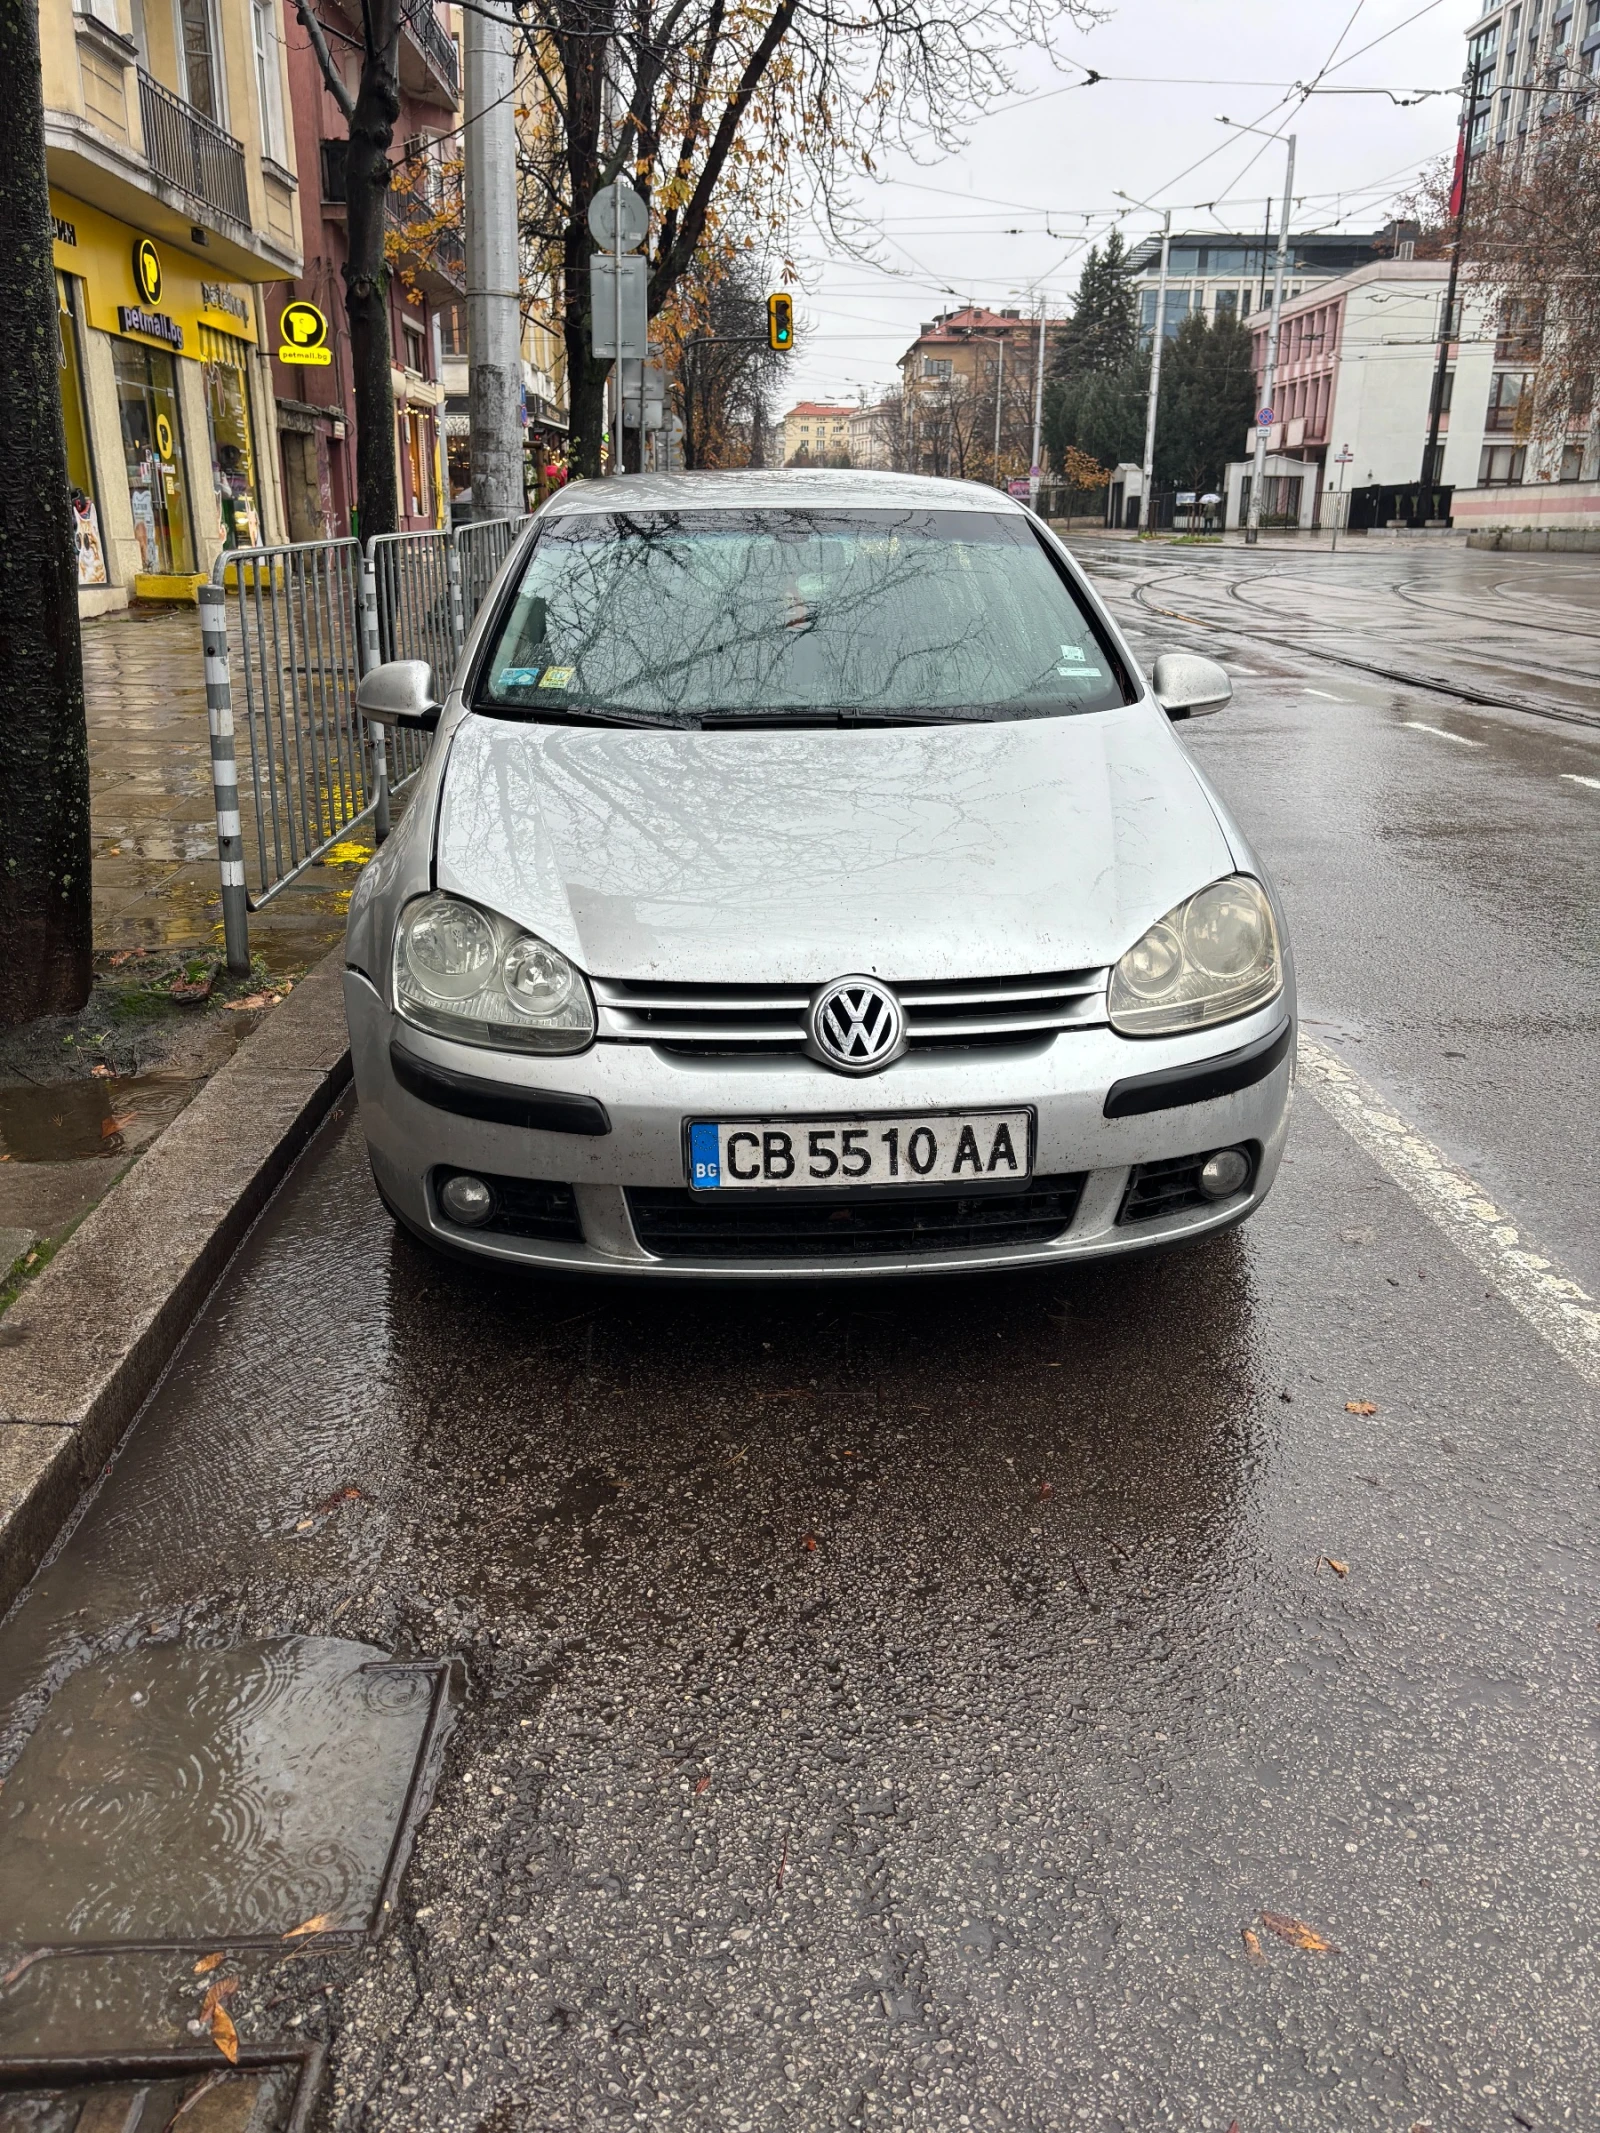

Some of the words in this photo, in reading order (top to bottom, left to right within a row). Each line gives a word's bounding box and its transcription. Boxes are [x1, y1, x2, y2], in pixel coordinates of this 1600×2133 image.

[120, 306, 183, 349] petmall.bg
[282, 352, 328, 361] petmall.bg
[727, 1131, 796, 1180] CB
[808, 1126, 938, 1179] 5510
[951, 1122, 1018, 1174] AA
[696, 1163, 718, 1178] BG
